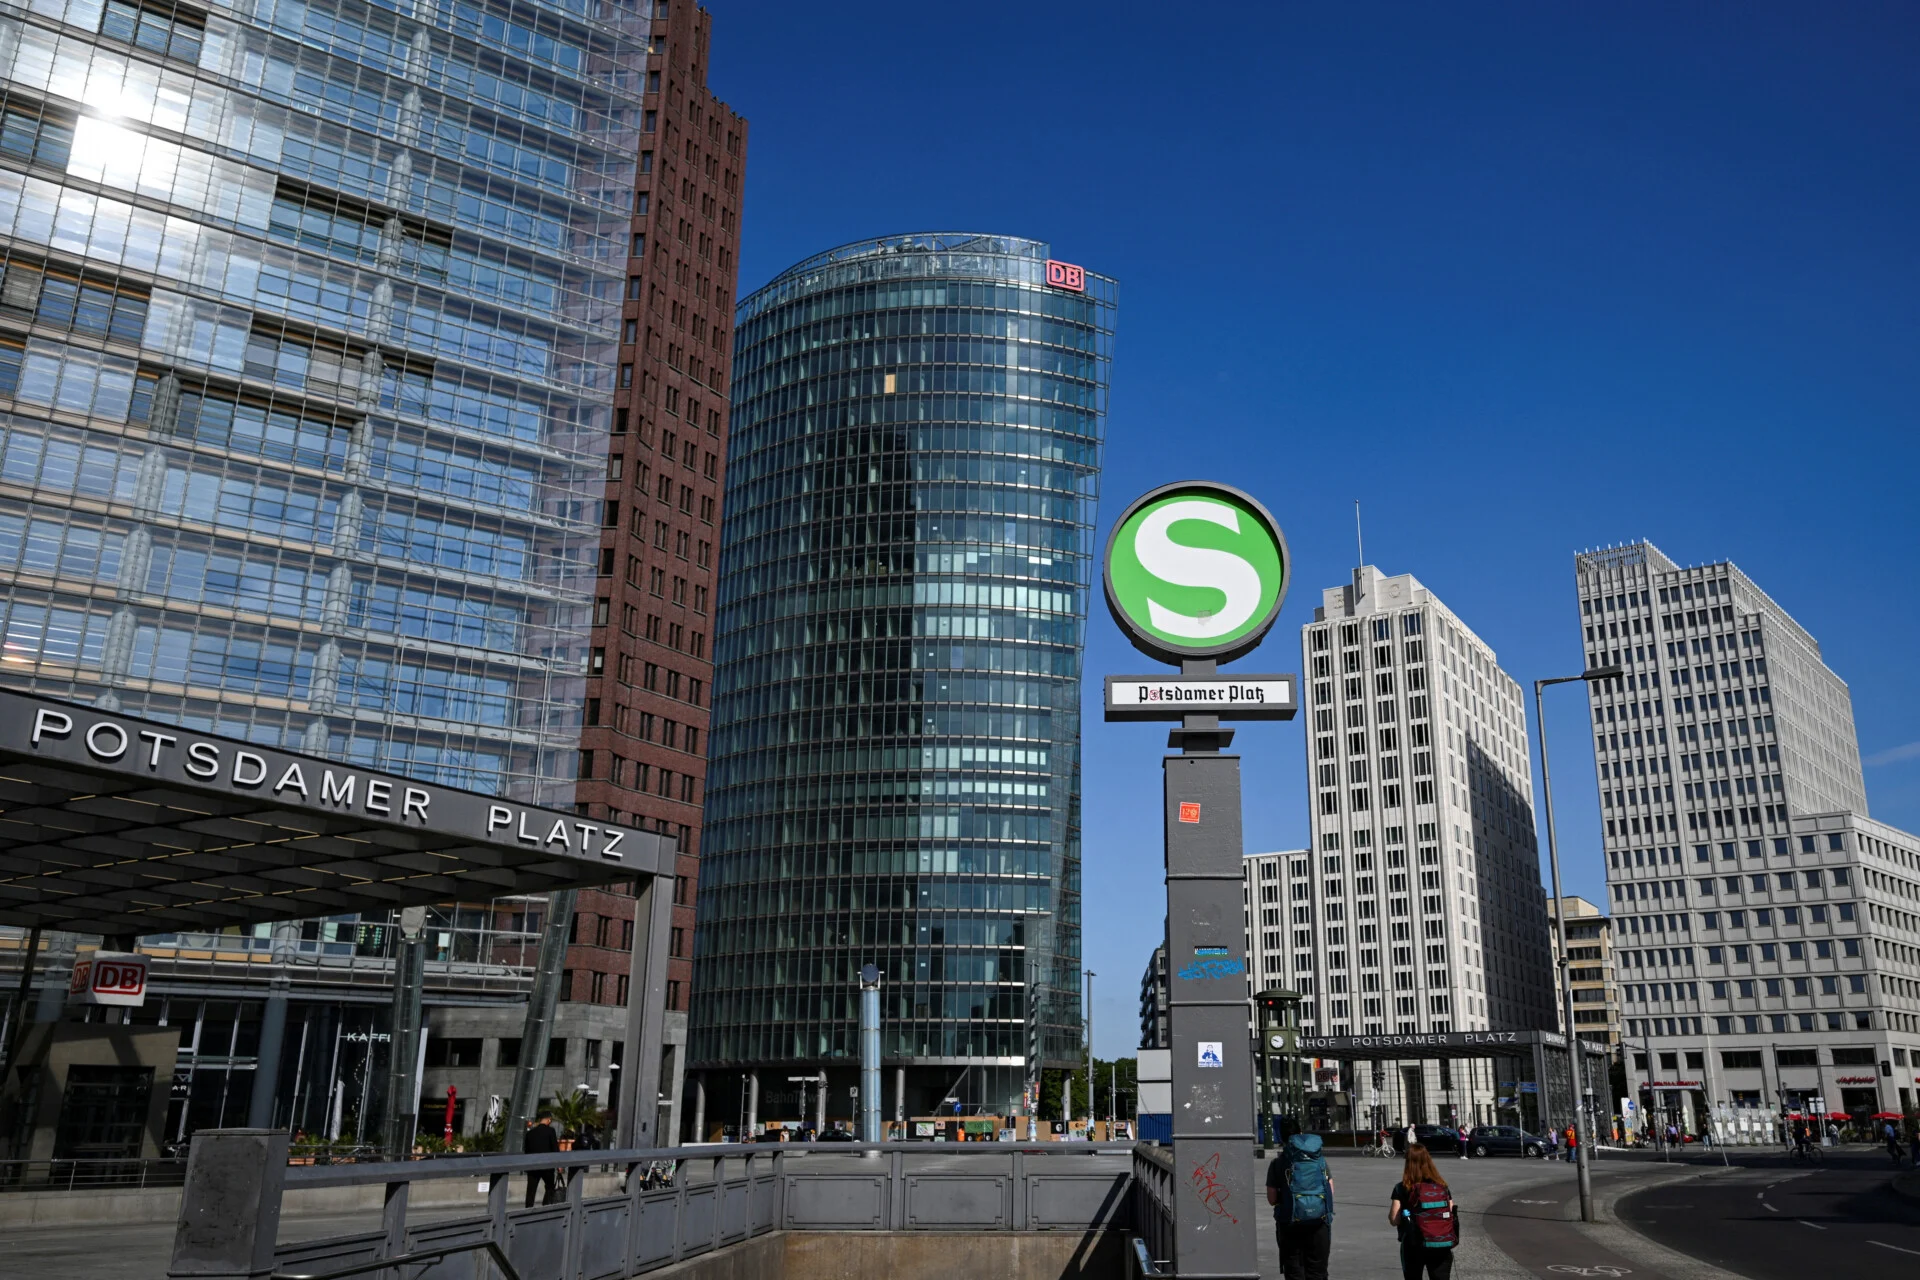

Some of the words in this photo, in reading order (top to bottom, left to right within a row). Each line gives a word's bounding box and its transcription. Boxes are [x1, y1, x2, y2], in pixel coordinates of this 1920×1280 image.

[1049, 263, 1081, 288] DB
[1134, 500, 1262, 639] S
[1138, 685, 1224, 704] Ptsdamer
[1228, 685, 1265, 704] Platz
[31, 708, 431, 820] POTSDAMER
[487, 805, 625, 858] PLATZ
[72, 965, 90, 991] DB
[98, 965, 141, 991] DB
[1352, 1034, 1447, 1047] POTSDAMER
[1464, 1032, 1517, 1043] PLATZ
[765, 1089, 832, 1105] BahnTwr
